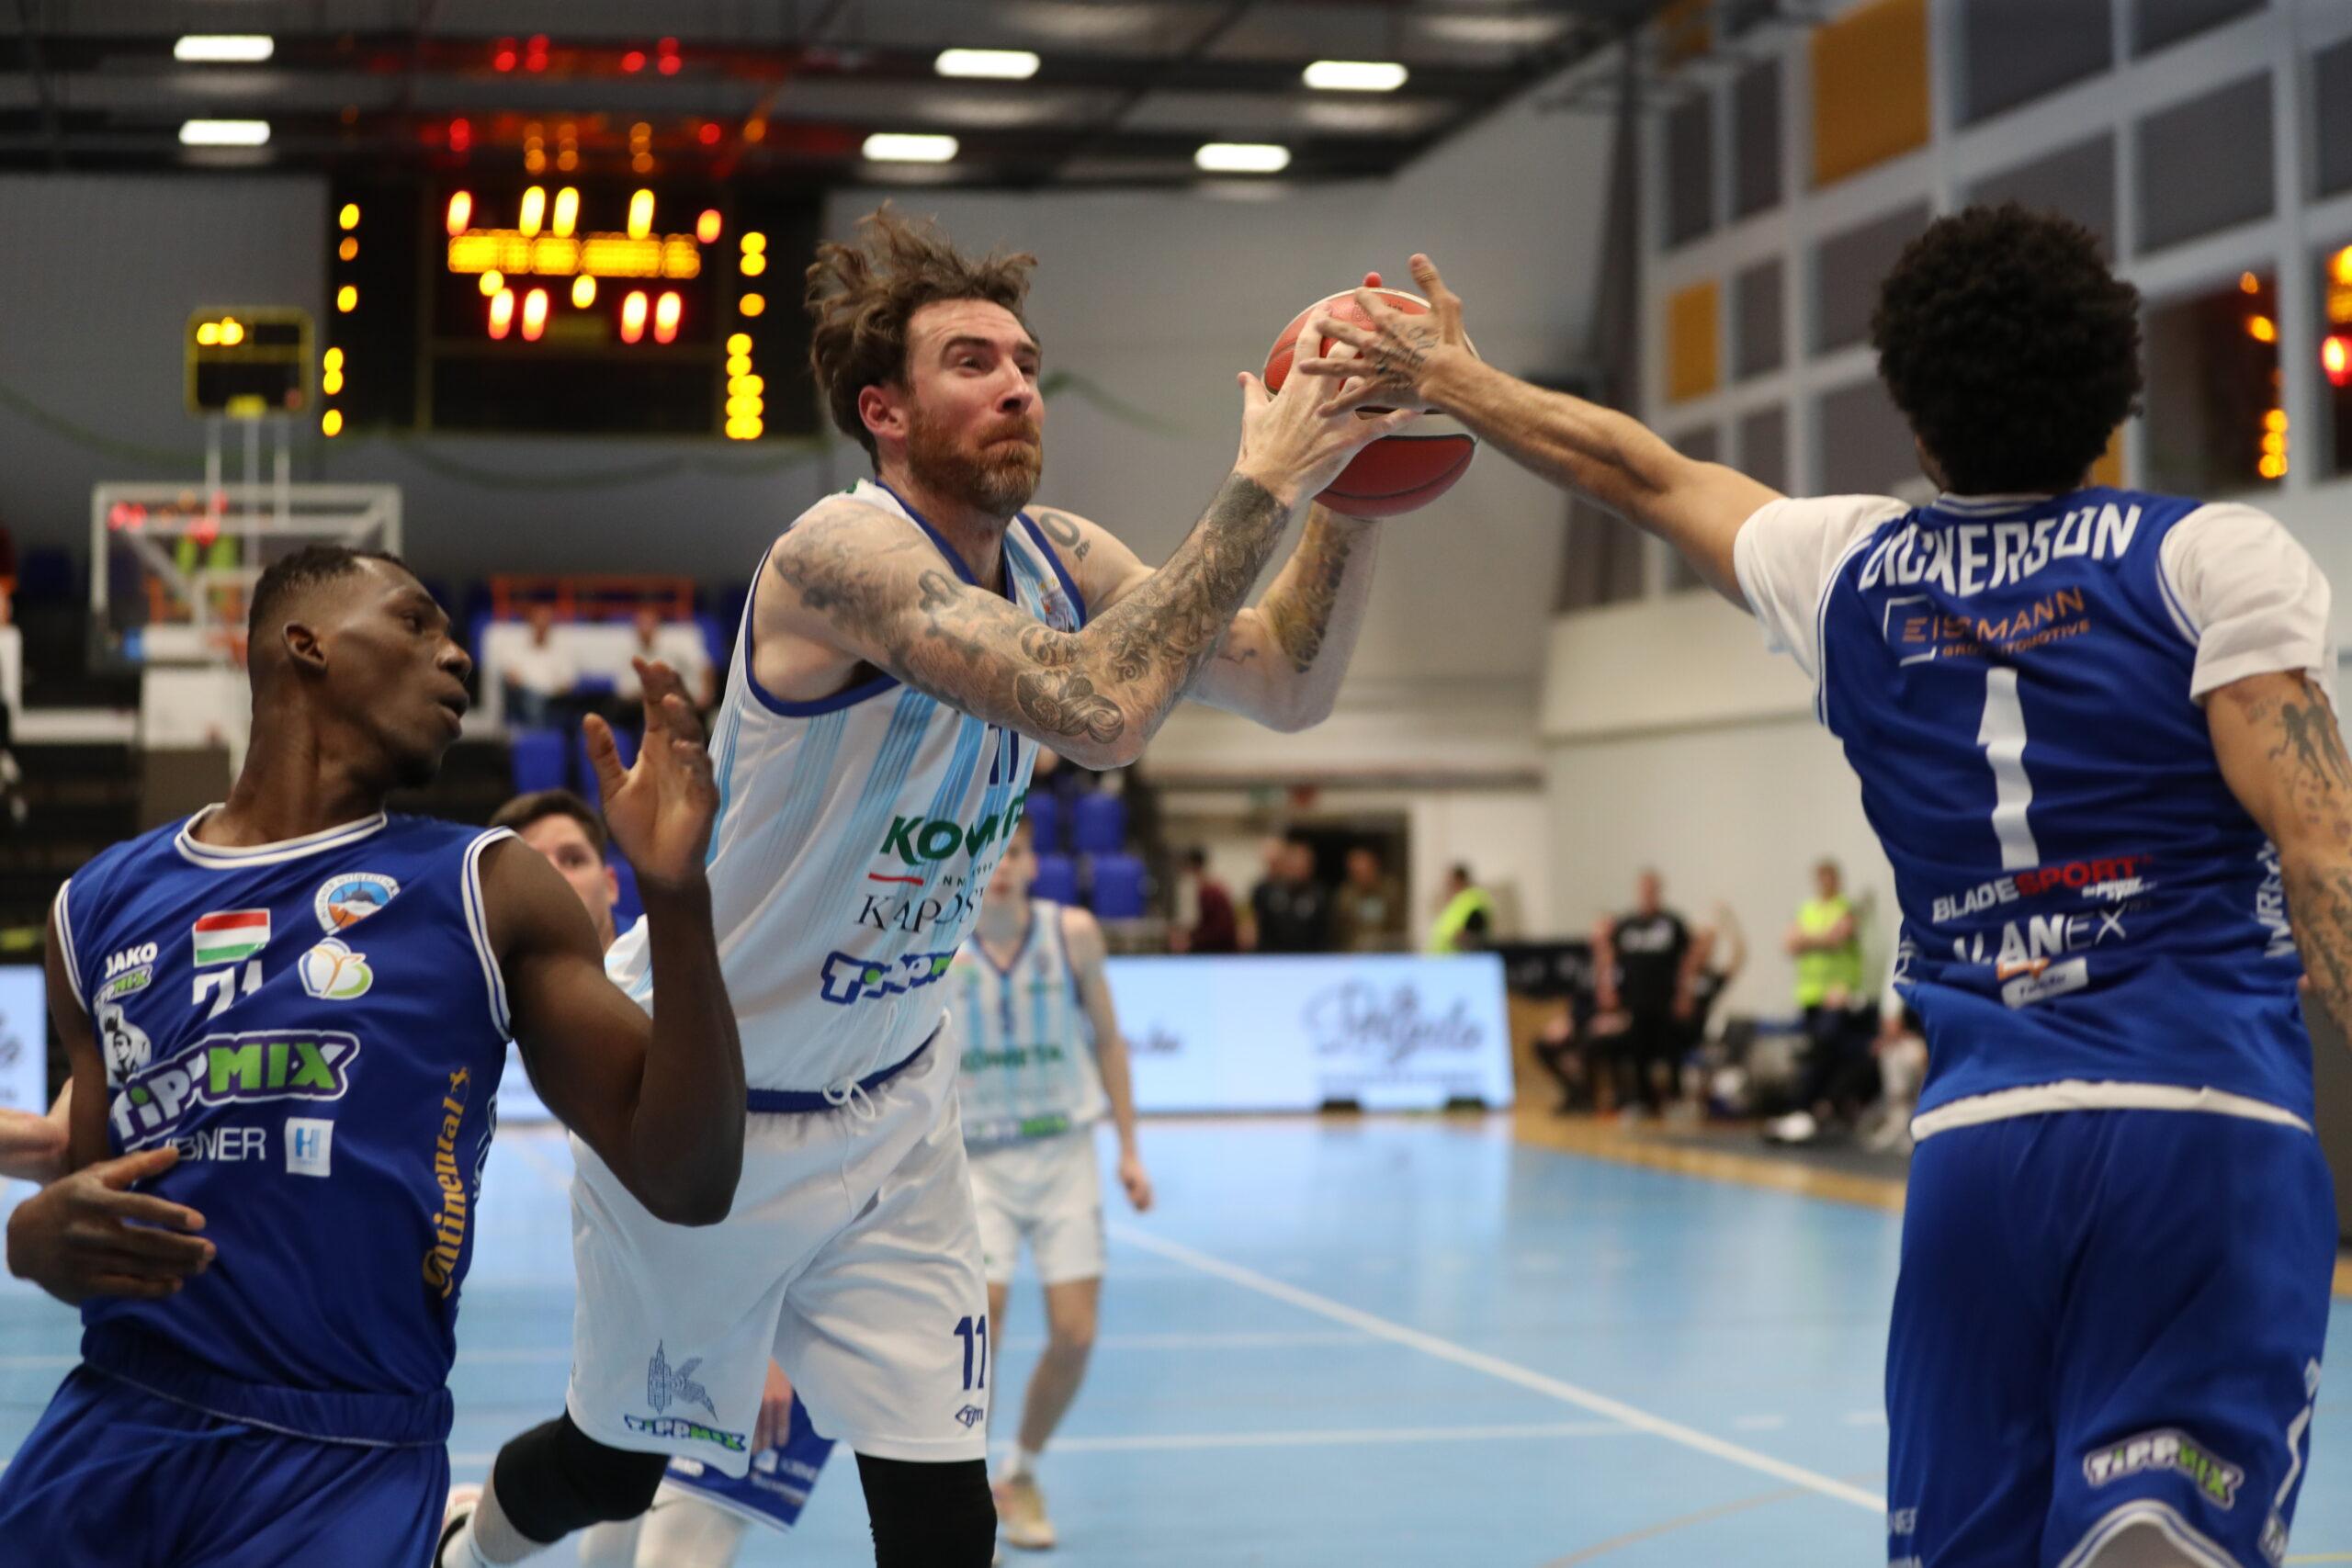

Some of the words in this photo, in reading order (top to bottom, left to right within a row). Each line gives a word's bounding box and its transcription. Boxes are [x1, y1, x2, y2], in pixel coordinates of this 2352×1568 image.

[1901, 584, 2086, 644] EISMANN
[1976, 667, 2041, 872] 1
[105, 942, 158, 979] JAKO
[165, 1127, 267, 1162] BNER
[423, 1097, 466, 1300] Cntinental
[954, 1314, 986, 1390] 11
